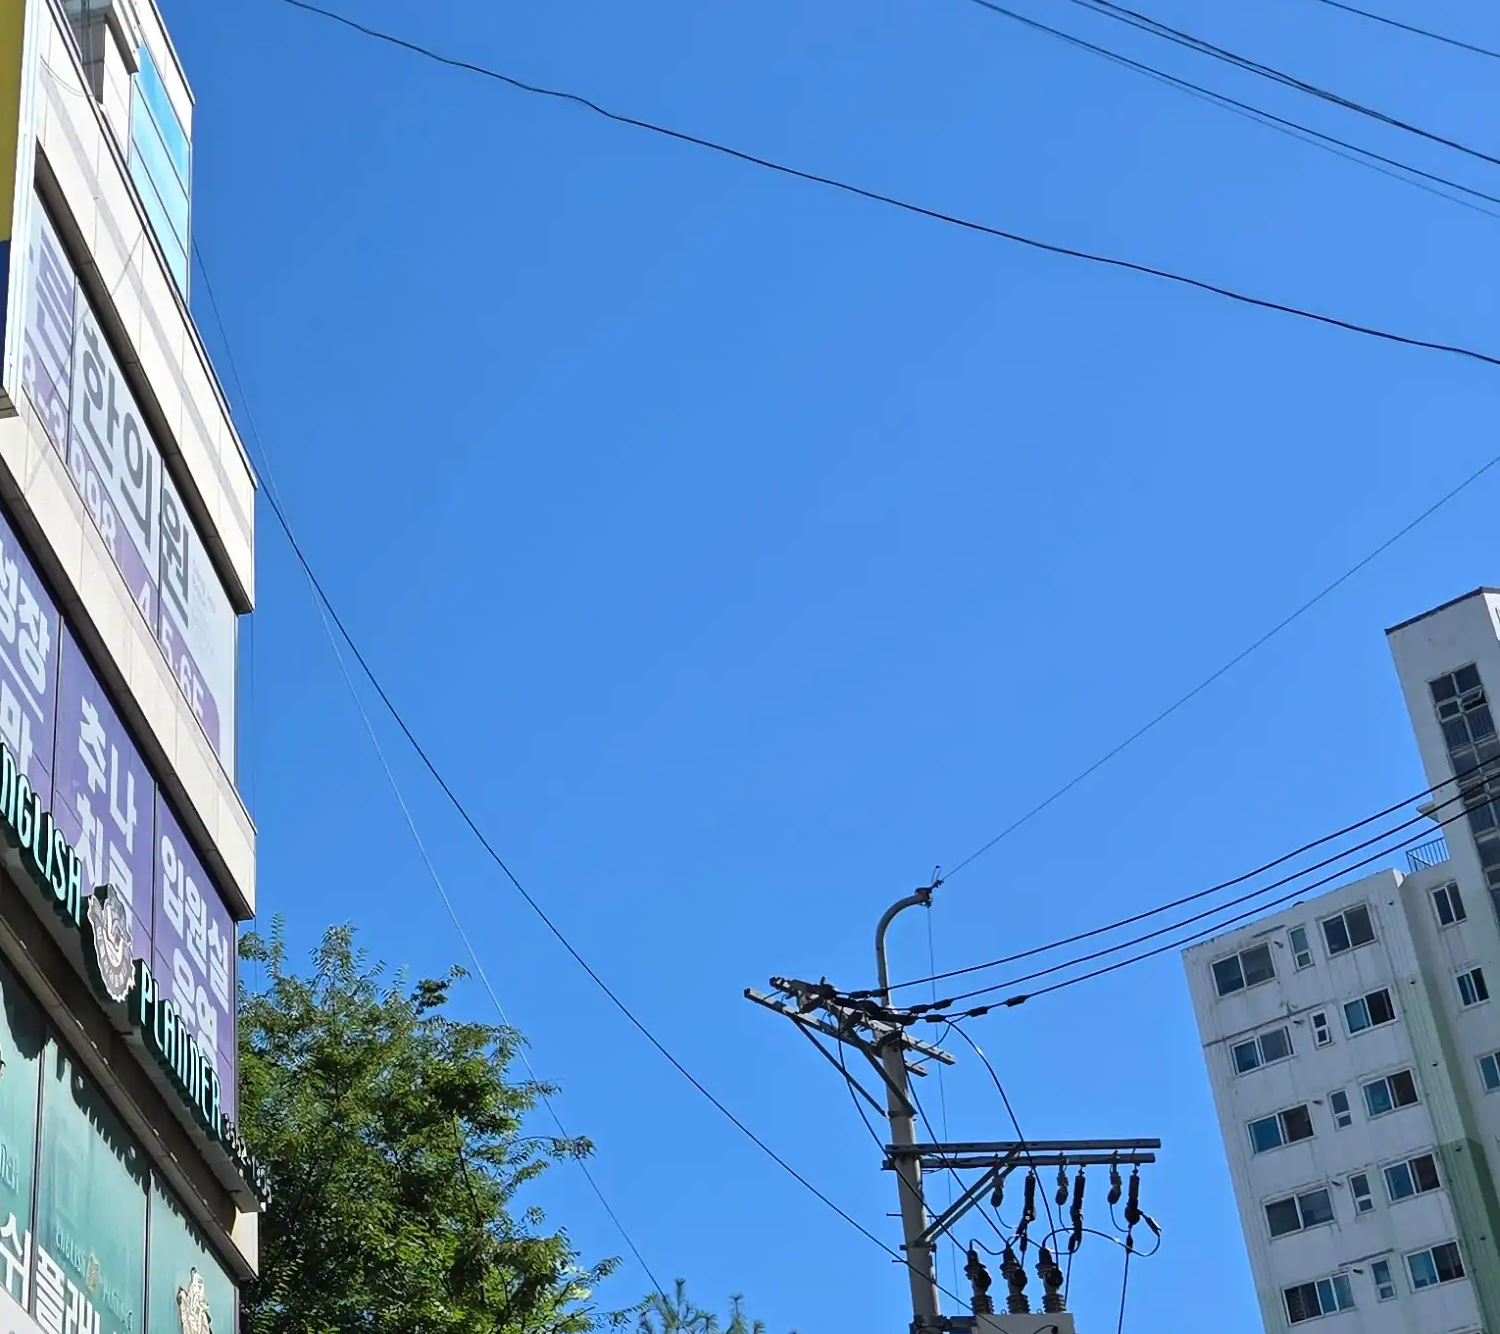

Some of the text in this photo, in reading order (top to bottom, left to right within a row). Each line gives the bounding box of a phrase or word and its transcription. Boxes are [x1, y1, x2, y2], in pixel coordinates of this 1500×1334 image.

[77, 695, 138, 853] 추나
[161, 835, 230, 1016] 입원실
[140, 960, 223, 1142] PLANNER
